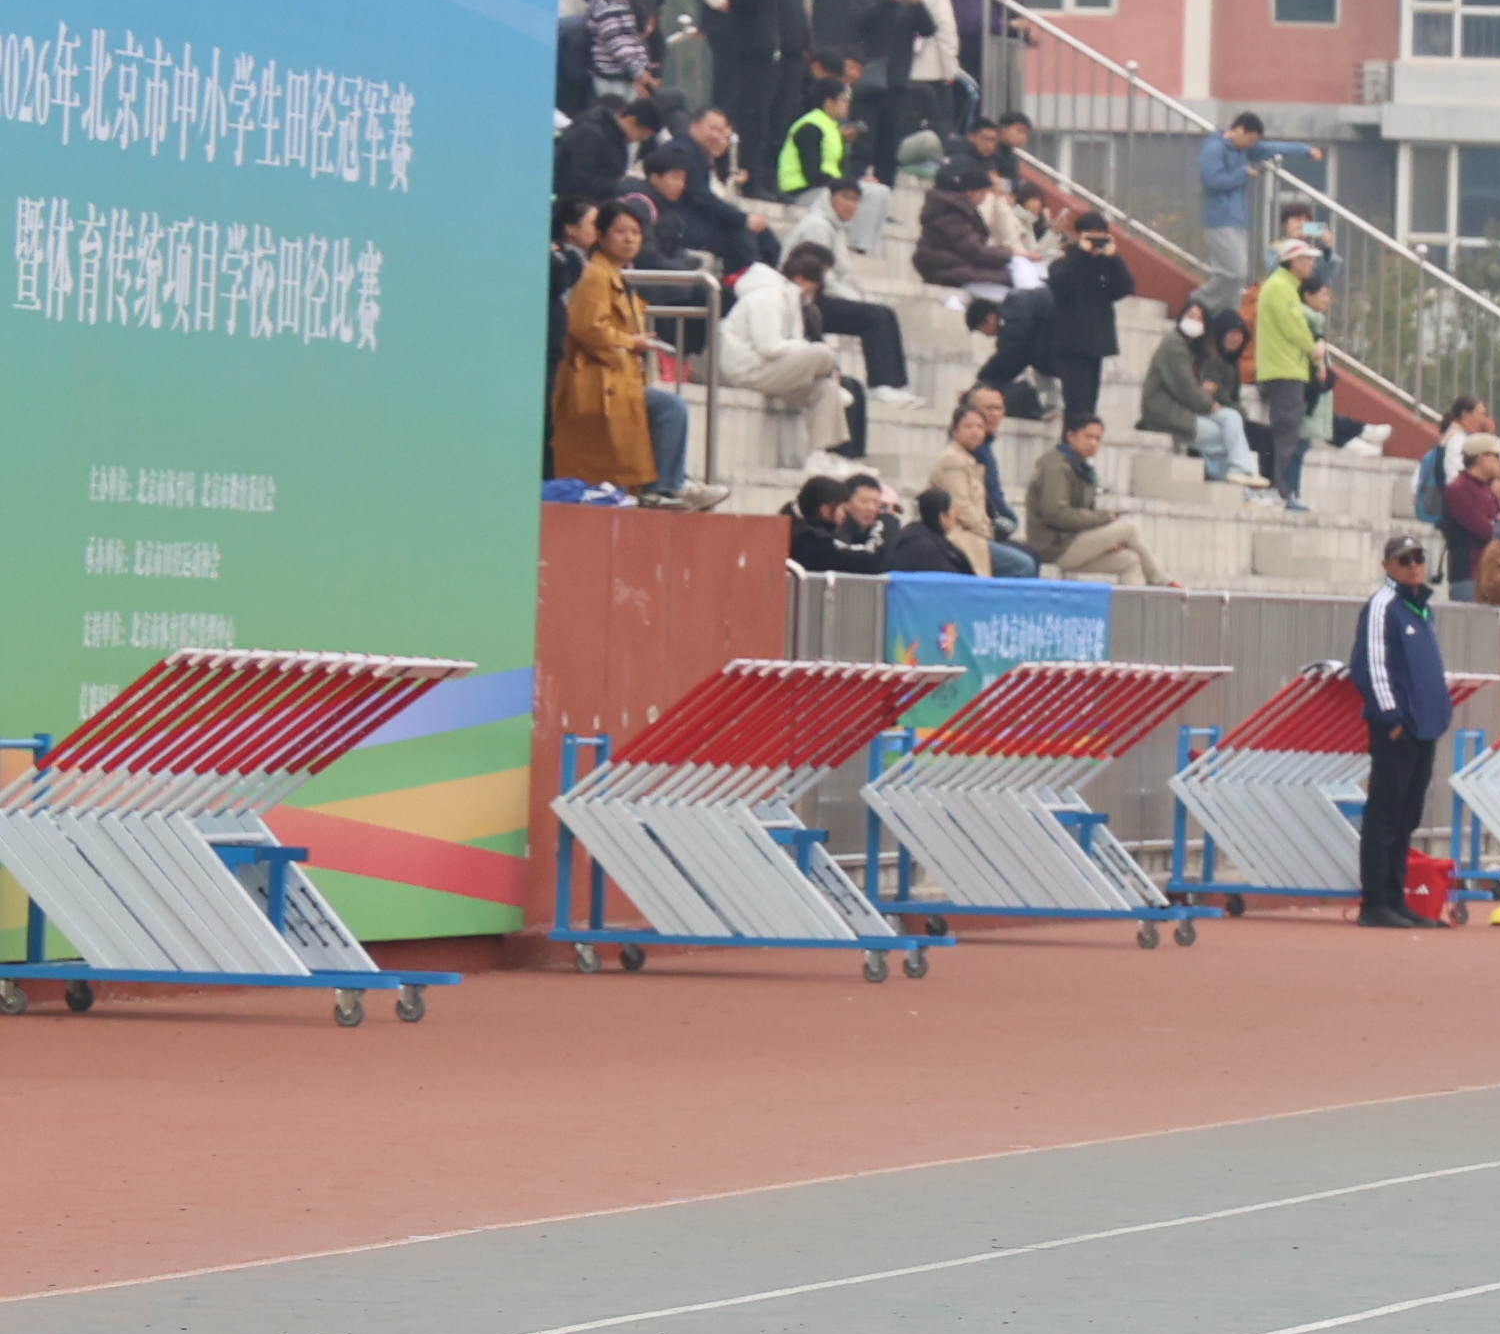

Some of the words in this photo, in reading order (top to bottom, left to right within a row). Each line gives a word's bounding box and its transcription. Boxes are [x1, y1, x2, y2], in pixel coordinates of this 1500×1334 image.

[0, 20, 414, 193] 026年北京市中小学生田径冠军赛
[12, 196, 383, 351] 暨体育传统项目学校田径比赛
